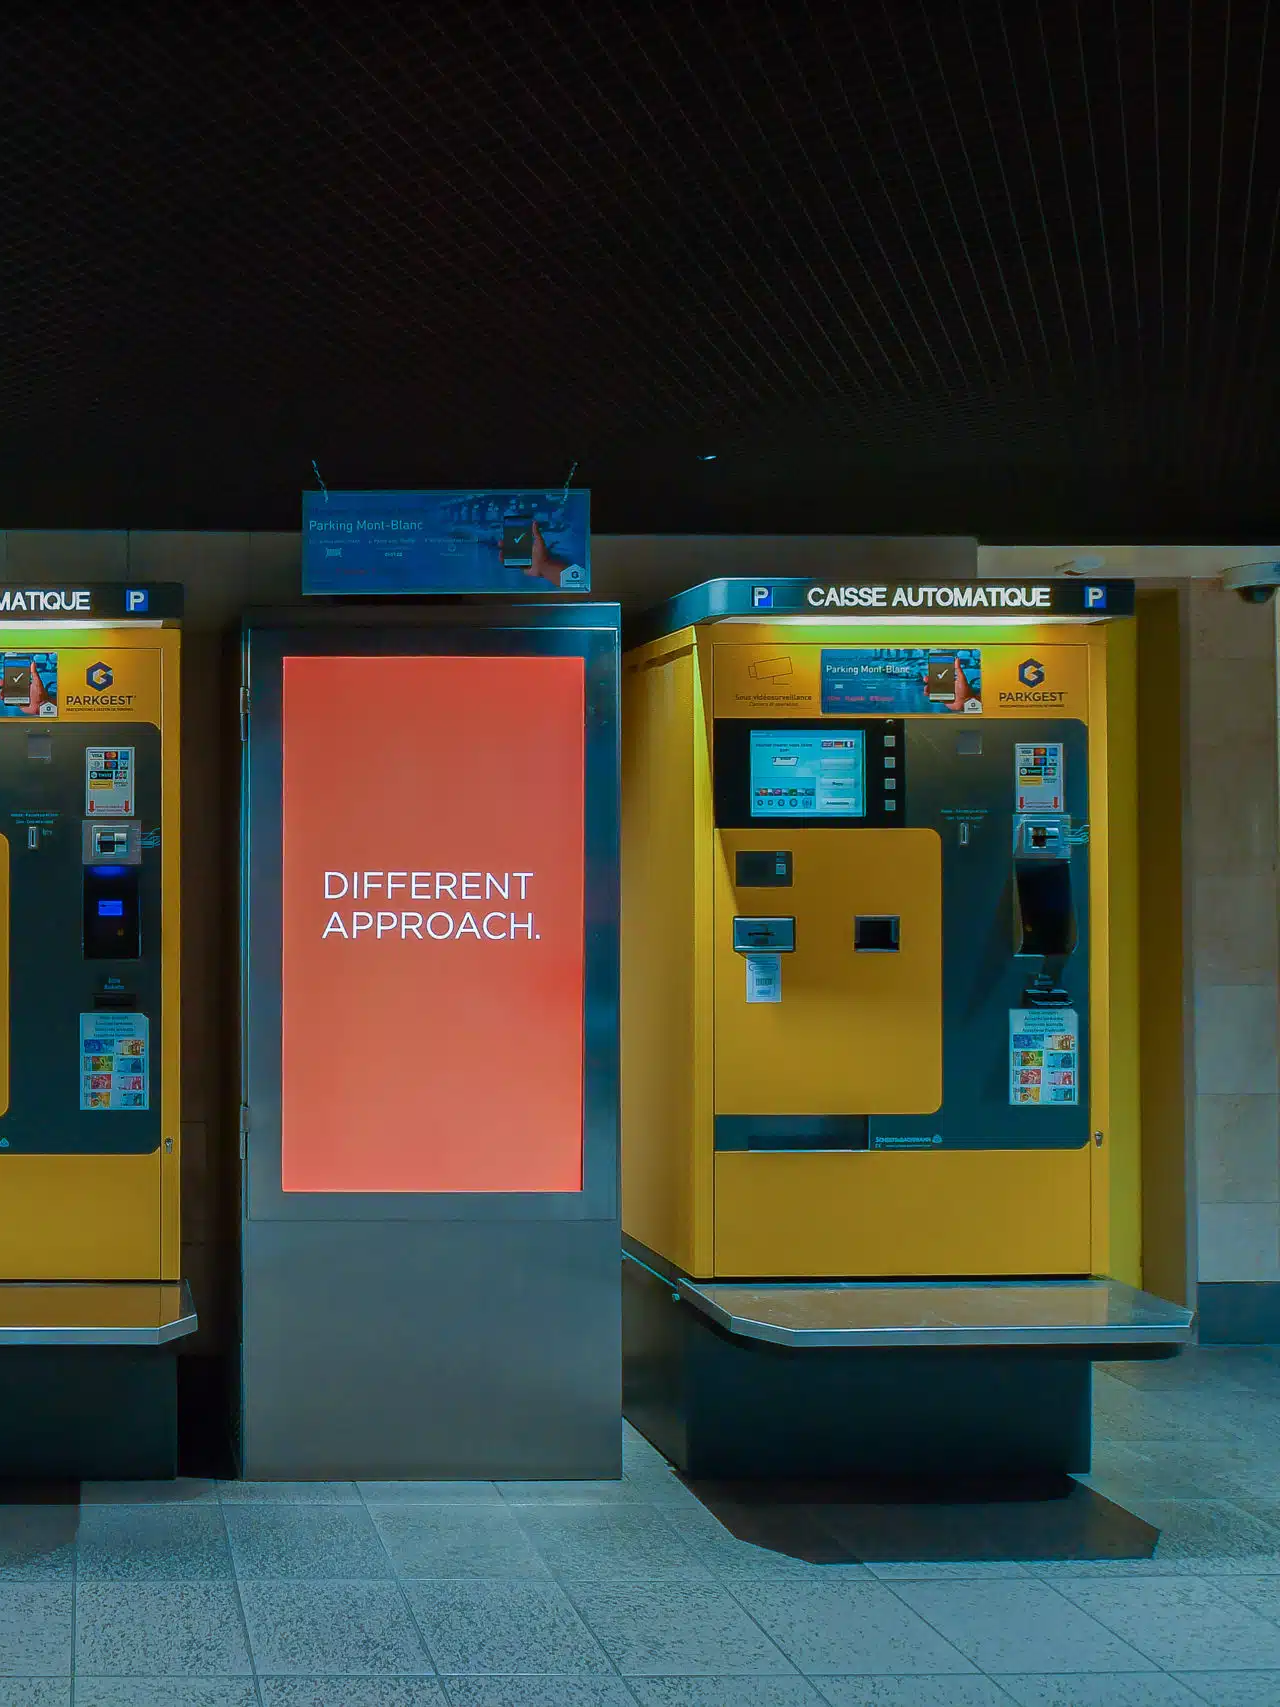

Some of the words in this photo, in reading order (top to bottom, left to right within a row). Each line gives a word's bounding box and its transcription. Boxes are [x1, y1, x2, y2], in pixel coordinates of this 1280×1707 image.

[309, 520, 352, 533] Parking
[357, 520, 423, 531] Mont-Blanc
[130, 591, 144, 609] P
[754, 588, 768, 607] P
[807, 588, 887, 607] CAISSE
[892, 588, 1051, 607] AUTOMATIQUE
[1089, 588, 1103, 607] P
[826, 665, 859, 675] Parking
[861, 664, 910, 674] Mont-Blanc
[66, 695, 133, 705] PARKGEST
[999, 691, 1064, 702] PARKGEST
[324, 871, 534, 900] DIFFERENT
[321, 911, 541, 940] APPROACH.
